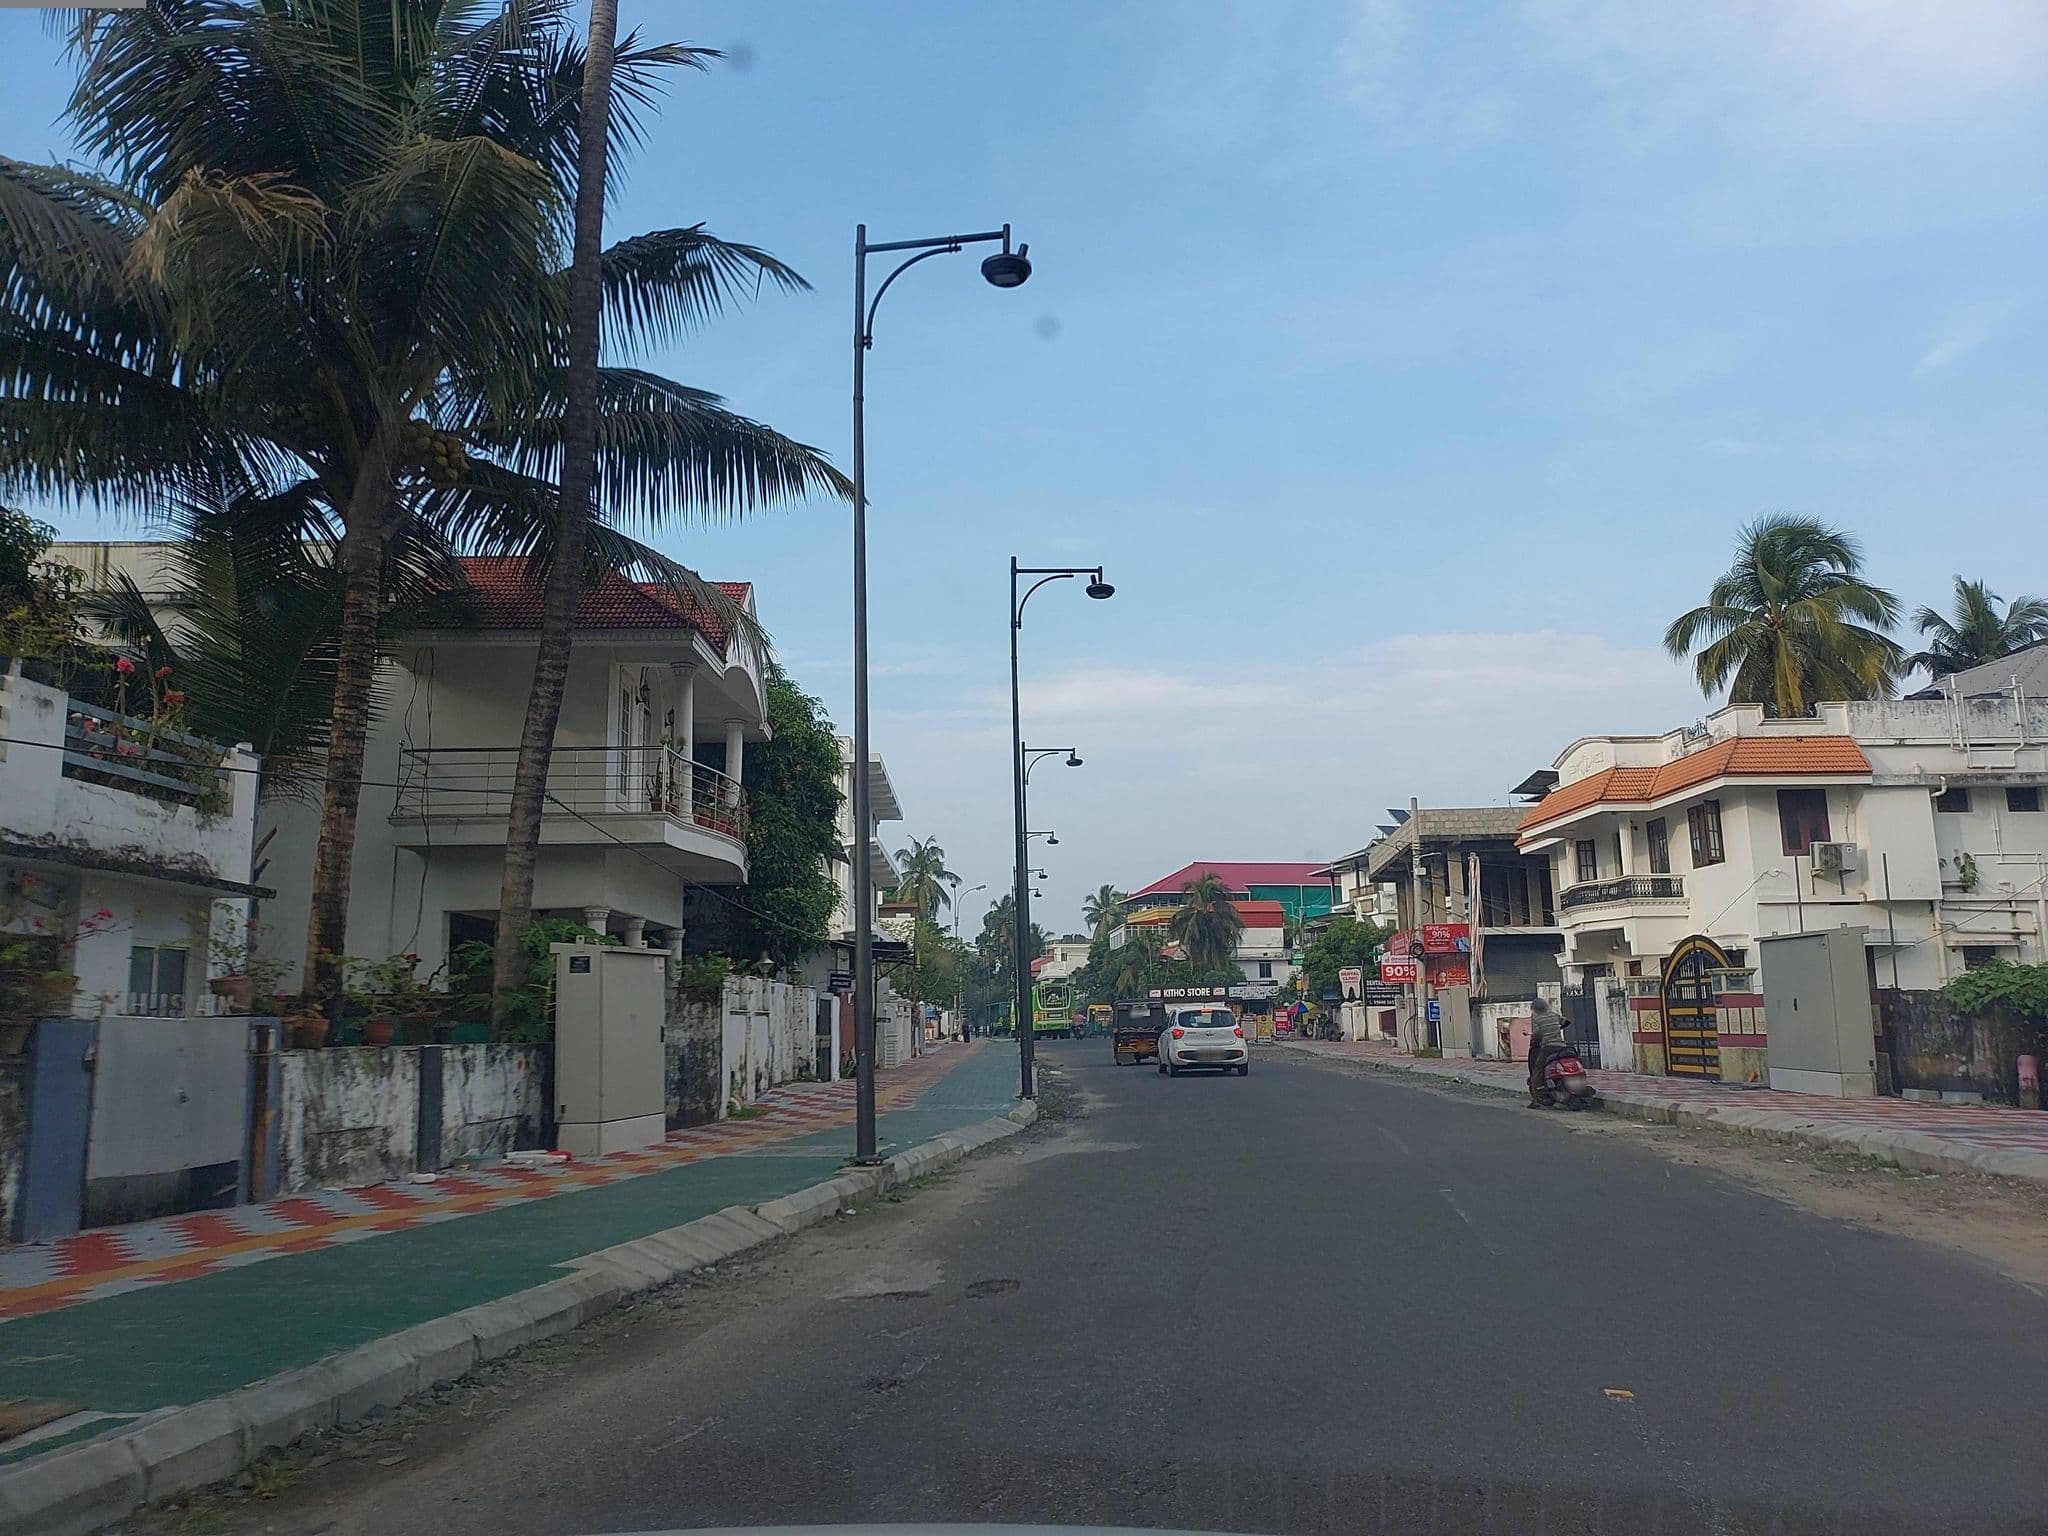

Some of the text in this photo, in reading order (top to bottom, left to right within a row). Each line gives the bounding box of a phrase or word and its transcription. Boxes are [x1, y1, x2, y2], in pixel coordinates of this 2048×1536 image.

[1432, 930, 1451, 939] 90%
[1385, 966, 1416, 977] 90%
[1163, 988, 1185, 998] KITHO
[1187, 987, 1211, 997] STORE
